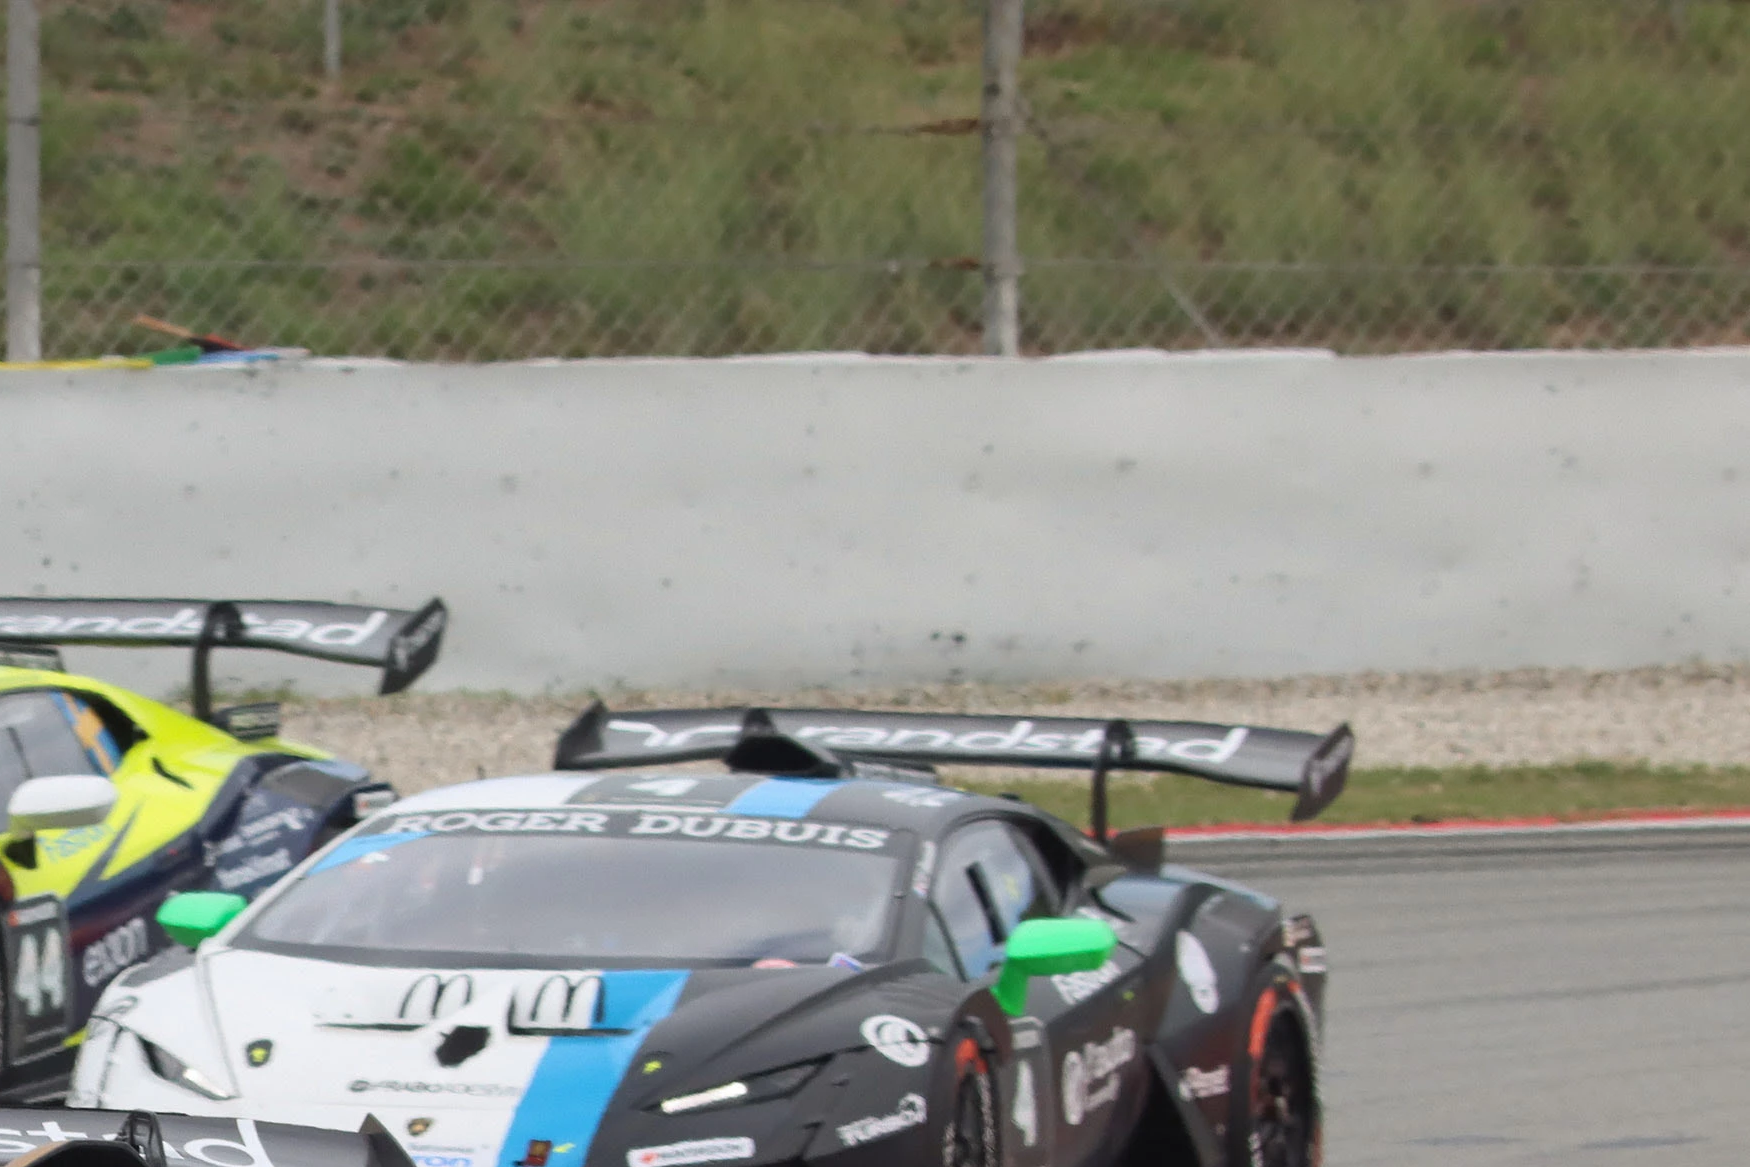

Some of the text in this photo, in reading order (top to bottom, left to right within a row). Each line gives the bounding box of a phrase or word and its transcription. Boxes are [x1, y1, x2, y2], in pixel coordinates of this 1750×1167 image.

[796, 720, 1249, 763] randstd
[385, 811, 891, 849] ROGER DUBUIS
